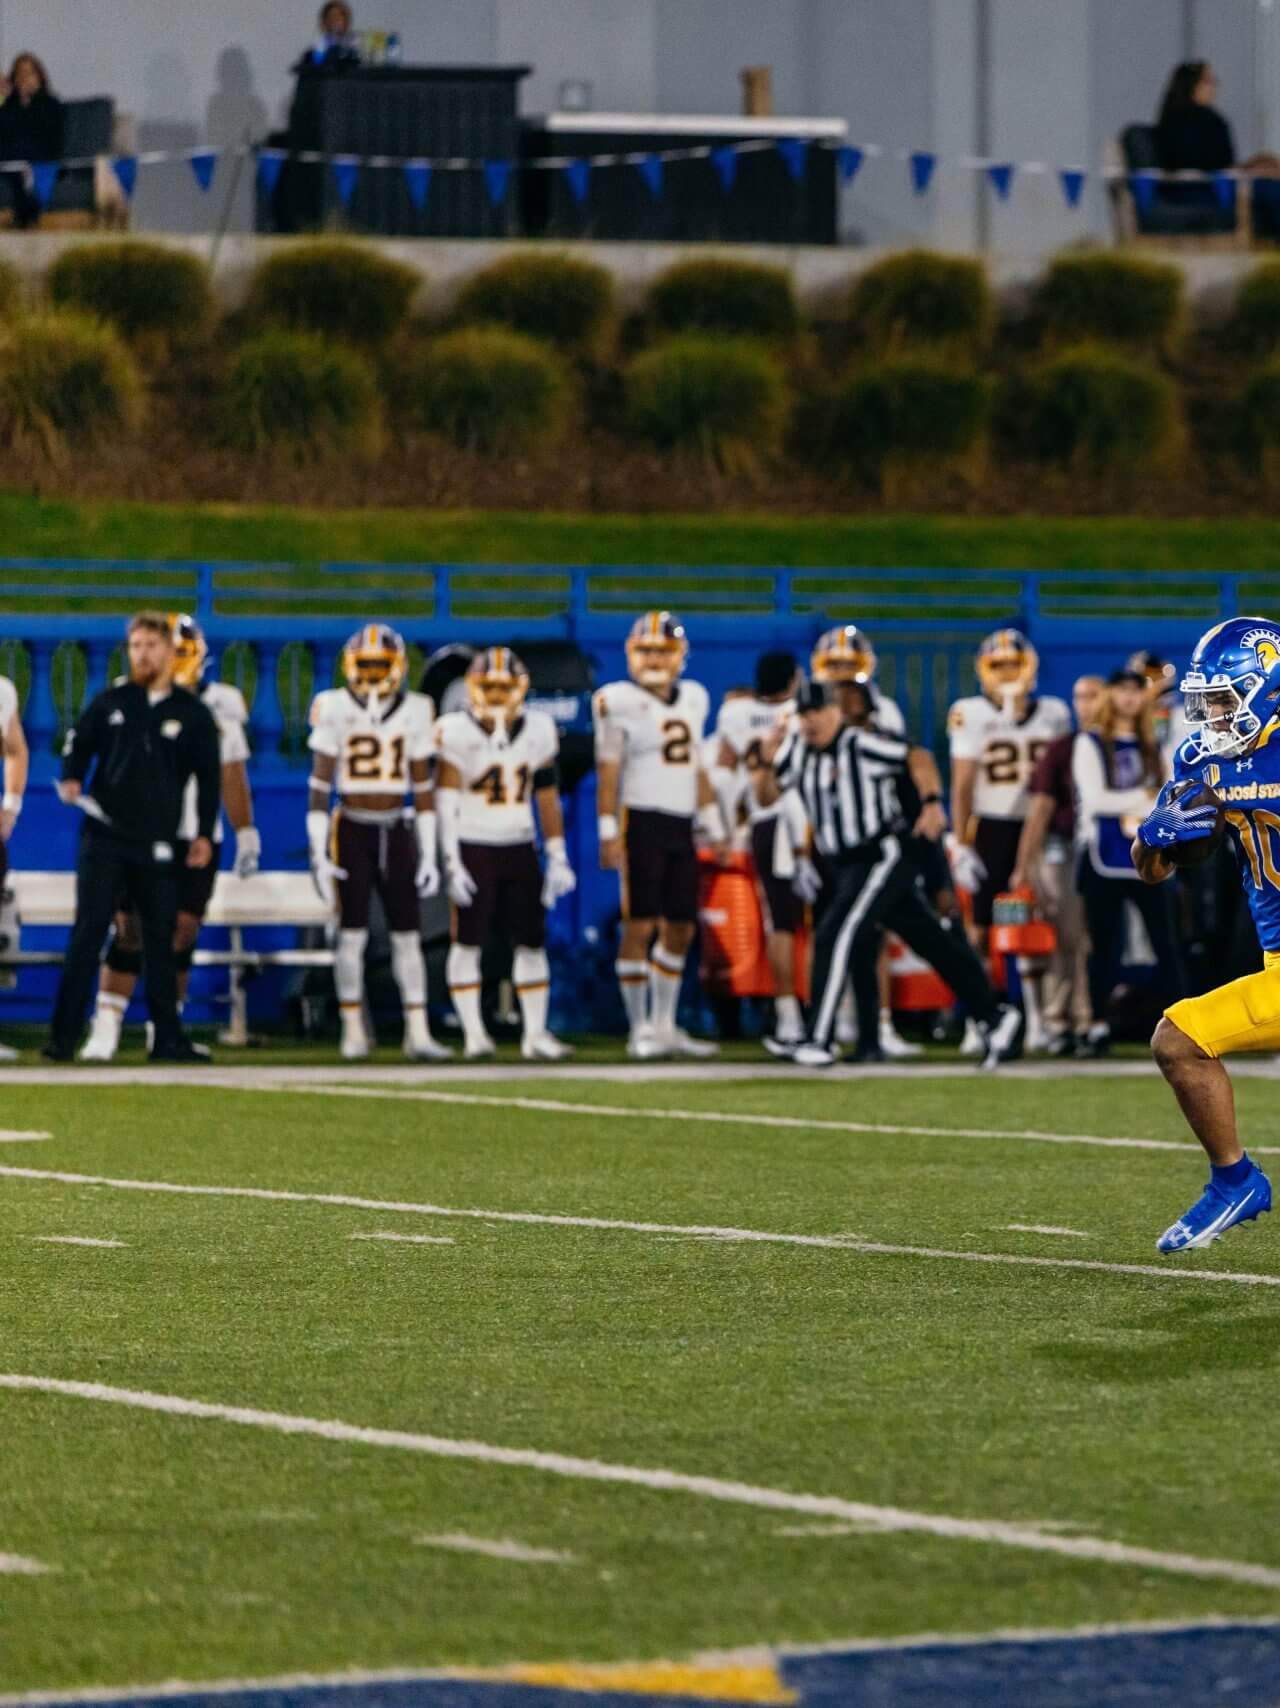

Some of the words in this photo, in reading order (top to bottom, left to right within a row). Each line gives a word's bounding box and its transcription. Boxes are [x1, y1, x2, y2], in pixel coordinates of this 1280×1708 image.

[346, 733, 406, 781] 21
[661, 717, 692, 767] 2
[470, 762, 531, 806] 41
[1227, 782, 1256, 801] JOSÉ
